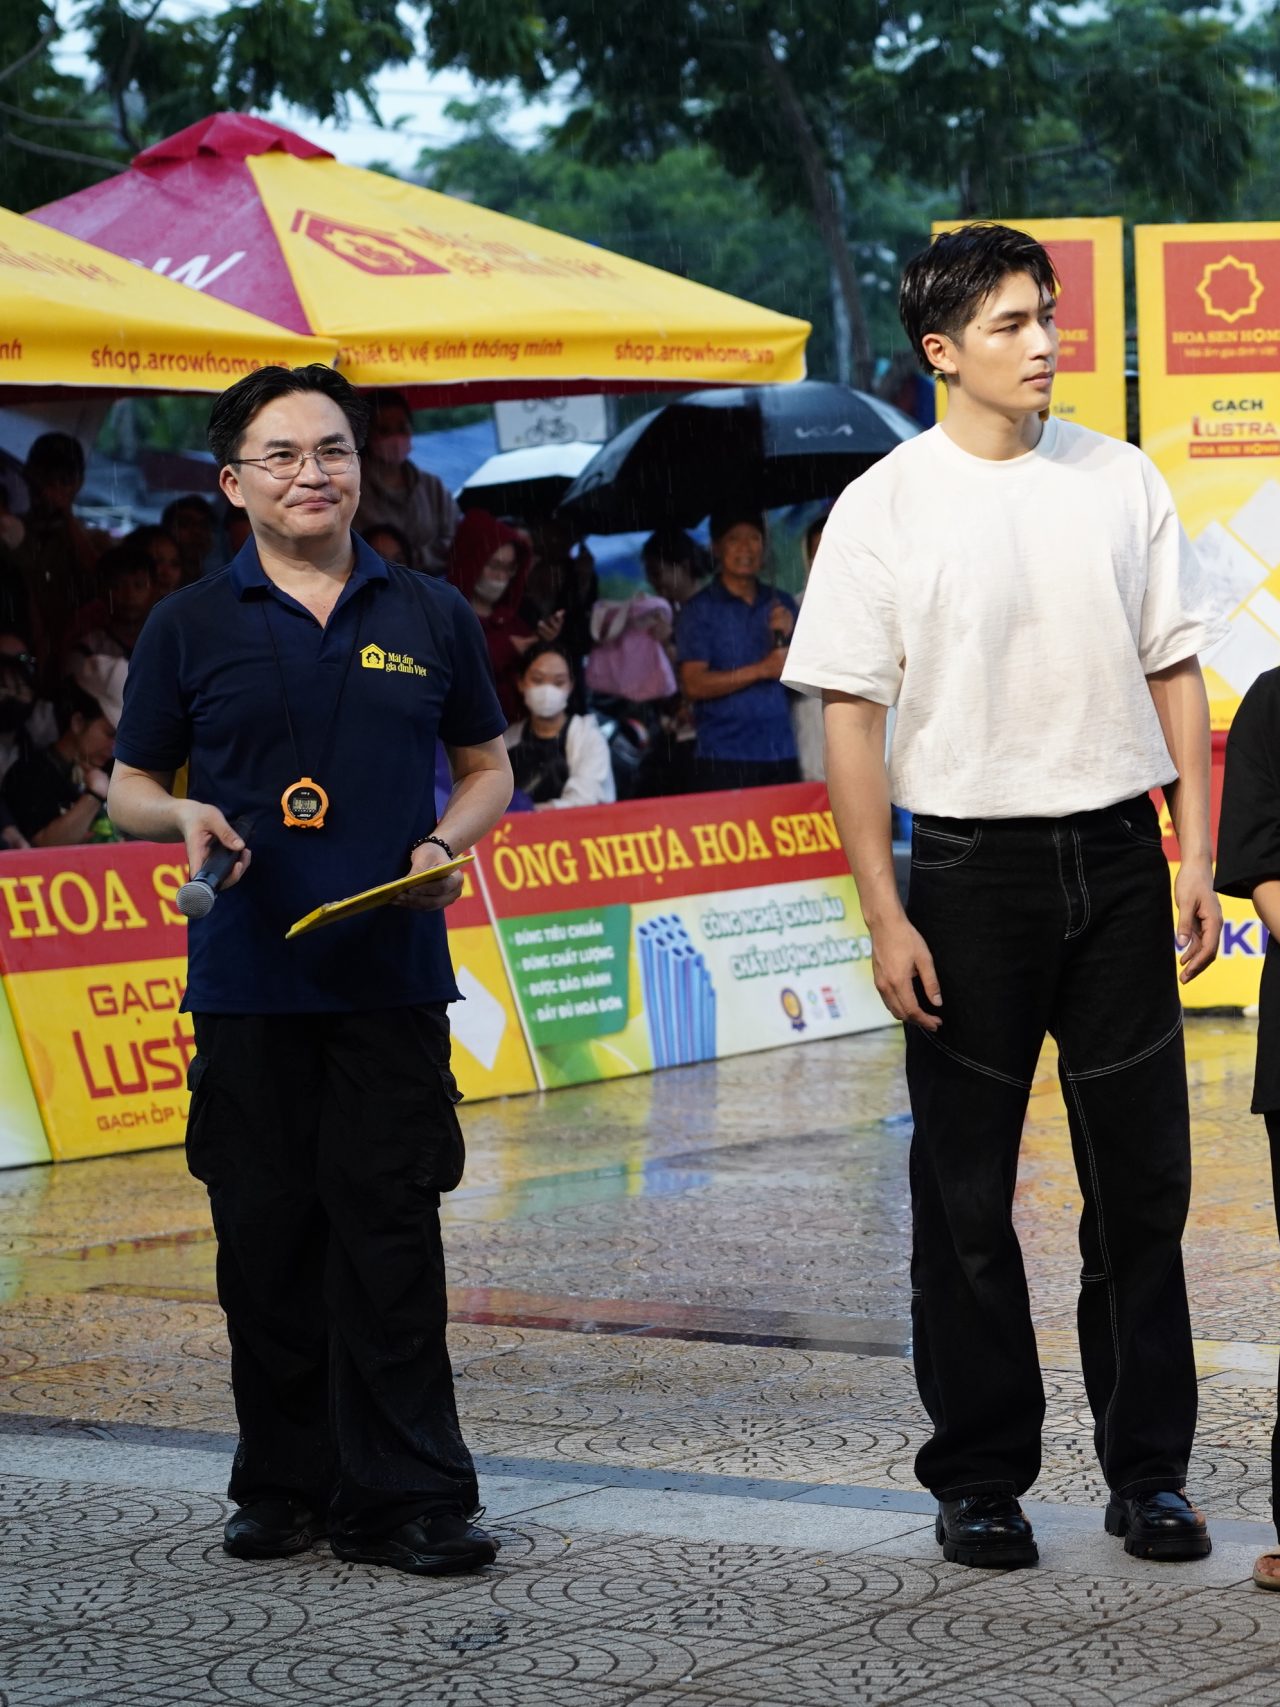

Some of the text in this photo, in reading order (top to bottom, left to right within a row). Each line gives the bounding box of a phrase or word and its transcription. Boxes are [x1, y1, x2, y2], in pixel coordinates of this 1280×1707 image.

[1172, 331, 1205, 344] HOA
[1207, 330, 1239, 343] SEN
[615, 340, 775, 365] shop.arrowhome.vn
[493, 823, 579, 891] ỐNG
[580, 824, 694, 885] NHỰA
[691, 820, 772, 867] HOA
[771, 810, 842, 857] SEN
[0, 869, 148, 939] HOA
[97, 1111, 147, 1134] GẠCH
